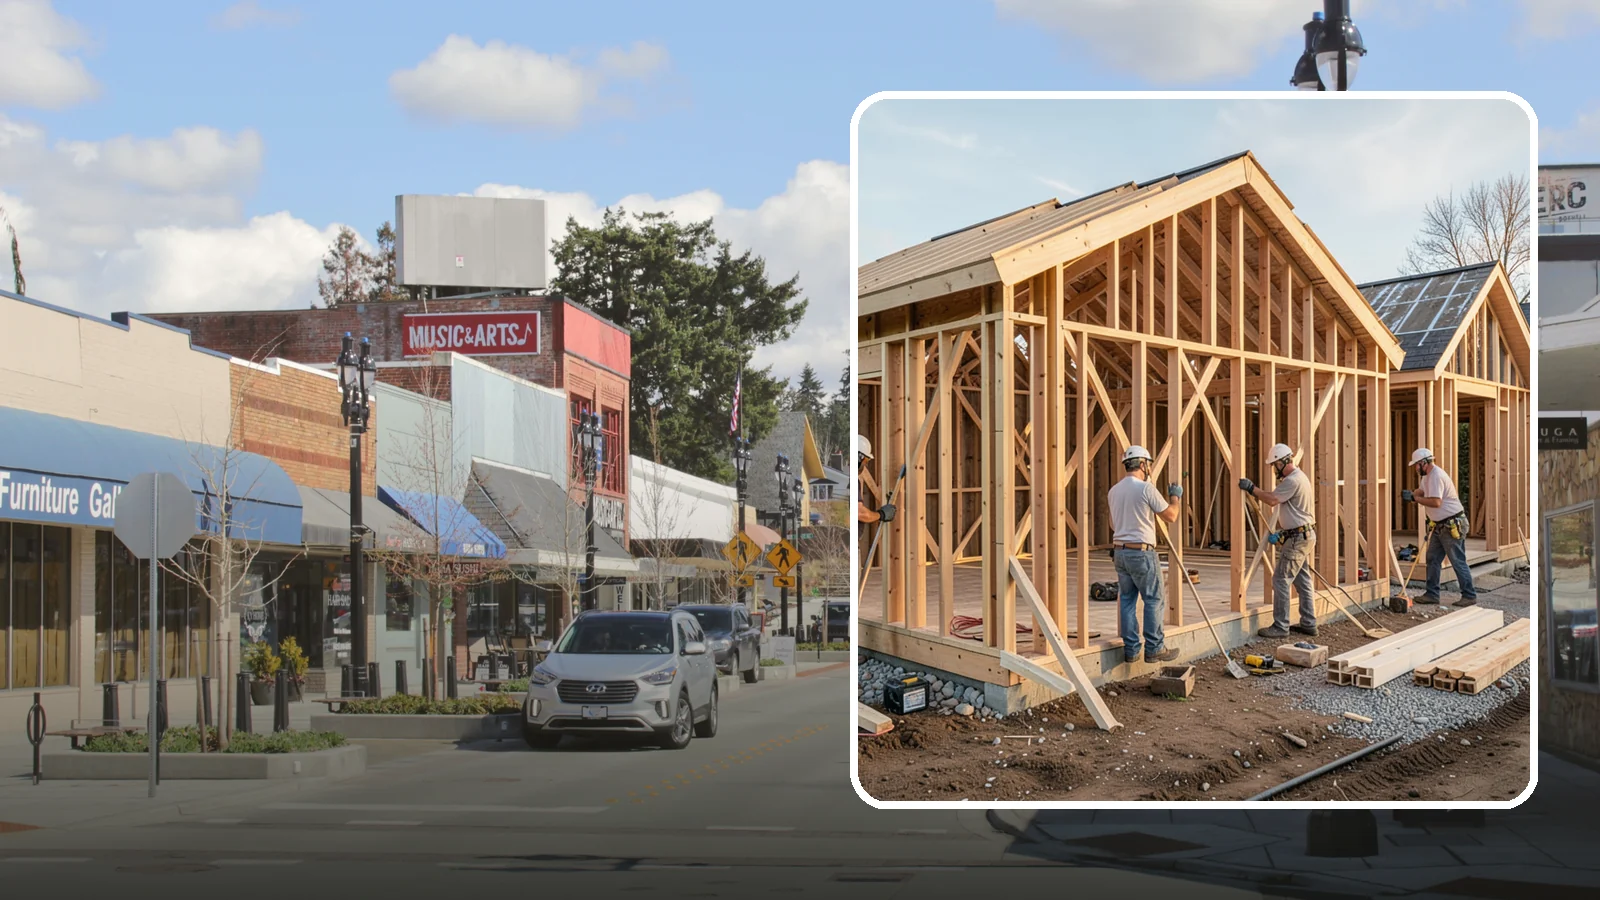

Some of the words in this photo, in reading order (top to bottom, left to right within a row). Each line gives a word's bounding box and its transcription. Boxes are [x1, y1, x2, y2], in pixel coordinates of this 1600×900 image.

[408, 323, 519, 349] MUSIC&ARTS
[0, 471, 79, 515] Furniture
[89, 482, 122, 519] Gal
